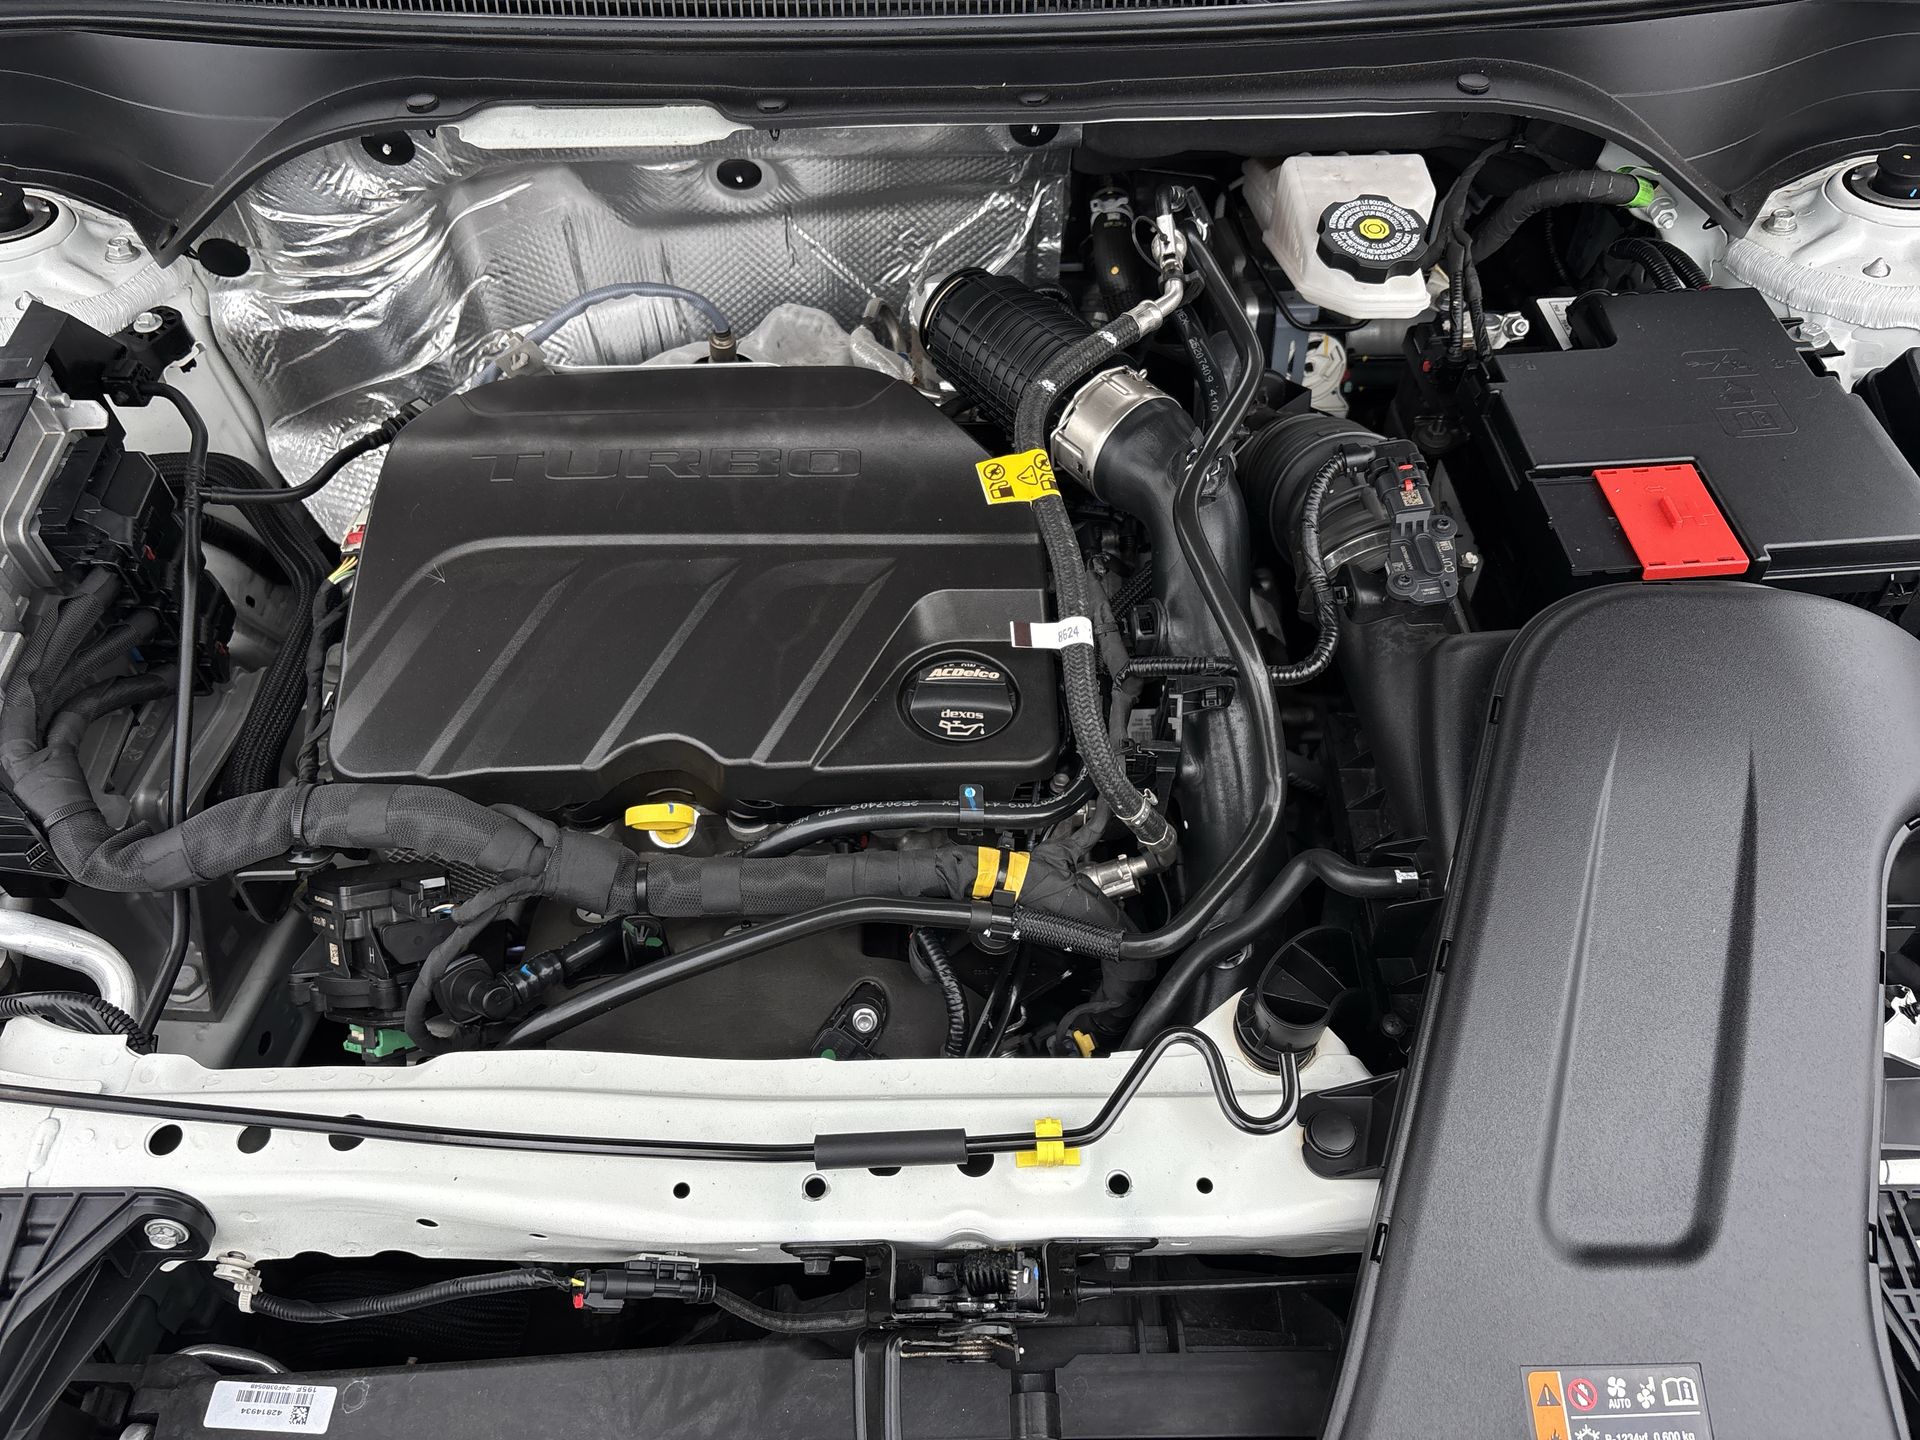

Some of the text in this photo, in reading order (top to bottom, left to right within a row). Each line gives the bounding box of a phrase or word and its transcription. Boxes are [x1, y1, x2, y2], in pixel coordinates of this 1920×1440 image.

[1356, 251, 1374, 260] FROM
[471, 448, 862, 482] TURBO
[1058, 625, 1079, 642] 8624
[928, 668, 1000, 679] ACDelco
[941, 709, 984, 719] dexos
[1609, 1398, 1632, 1409] AUTO
[241, 1406, 283, 1416] 42814934
[1653, 1431, 1680, 1440] 0600
[1682, 1430, 1695, 1440] kg
